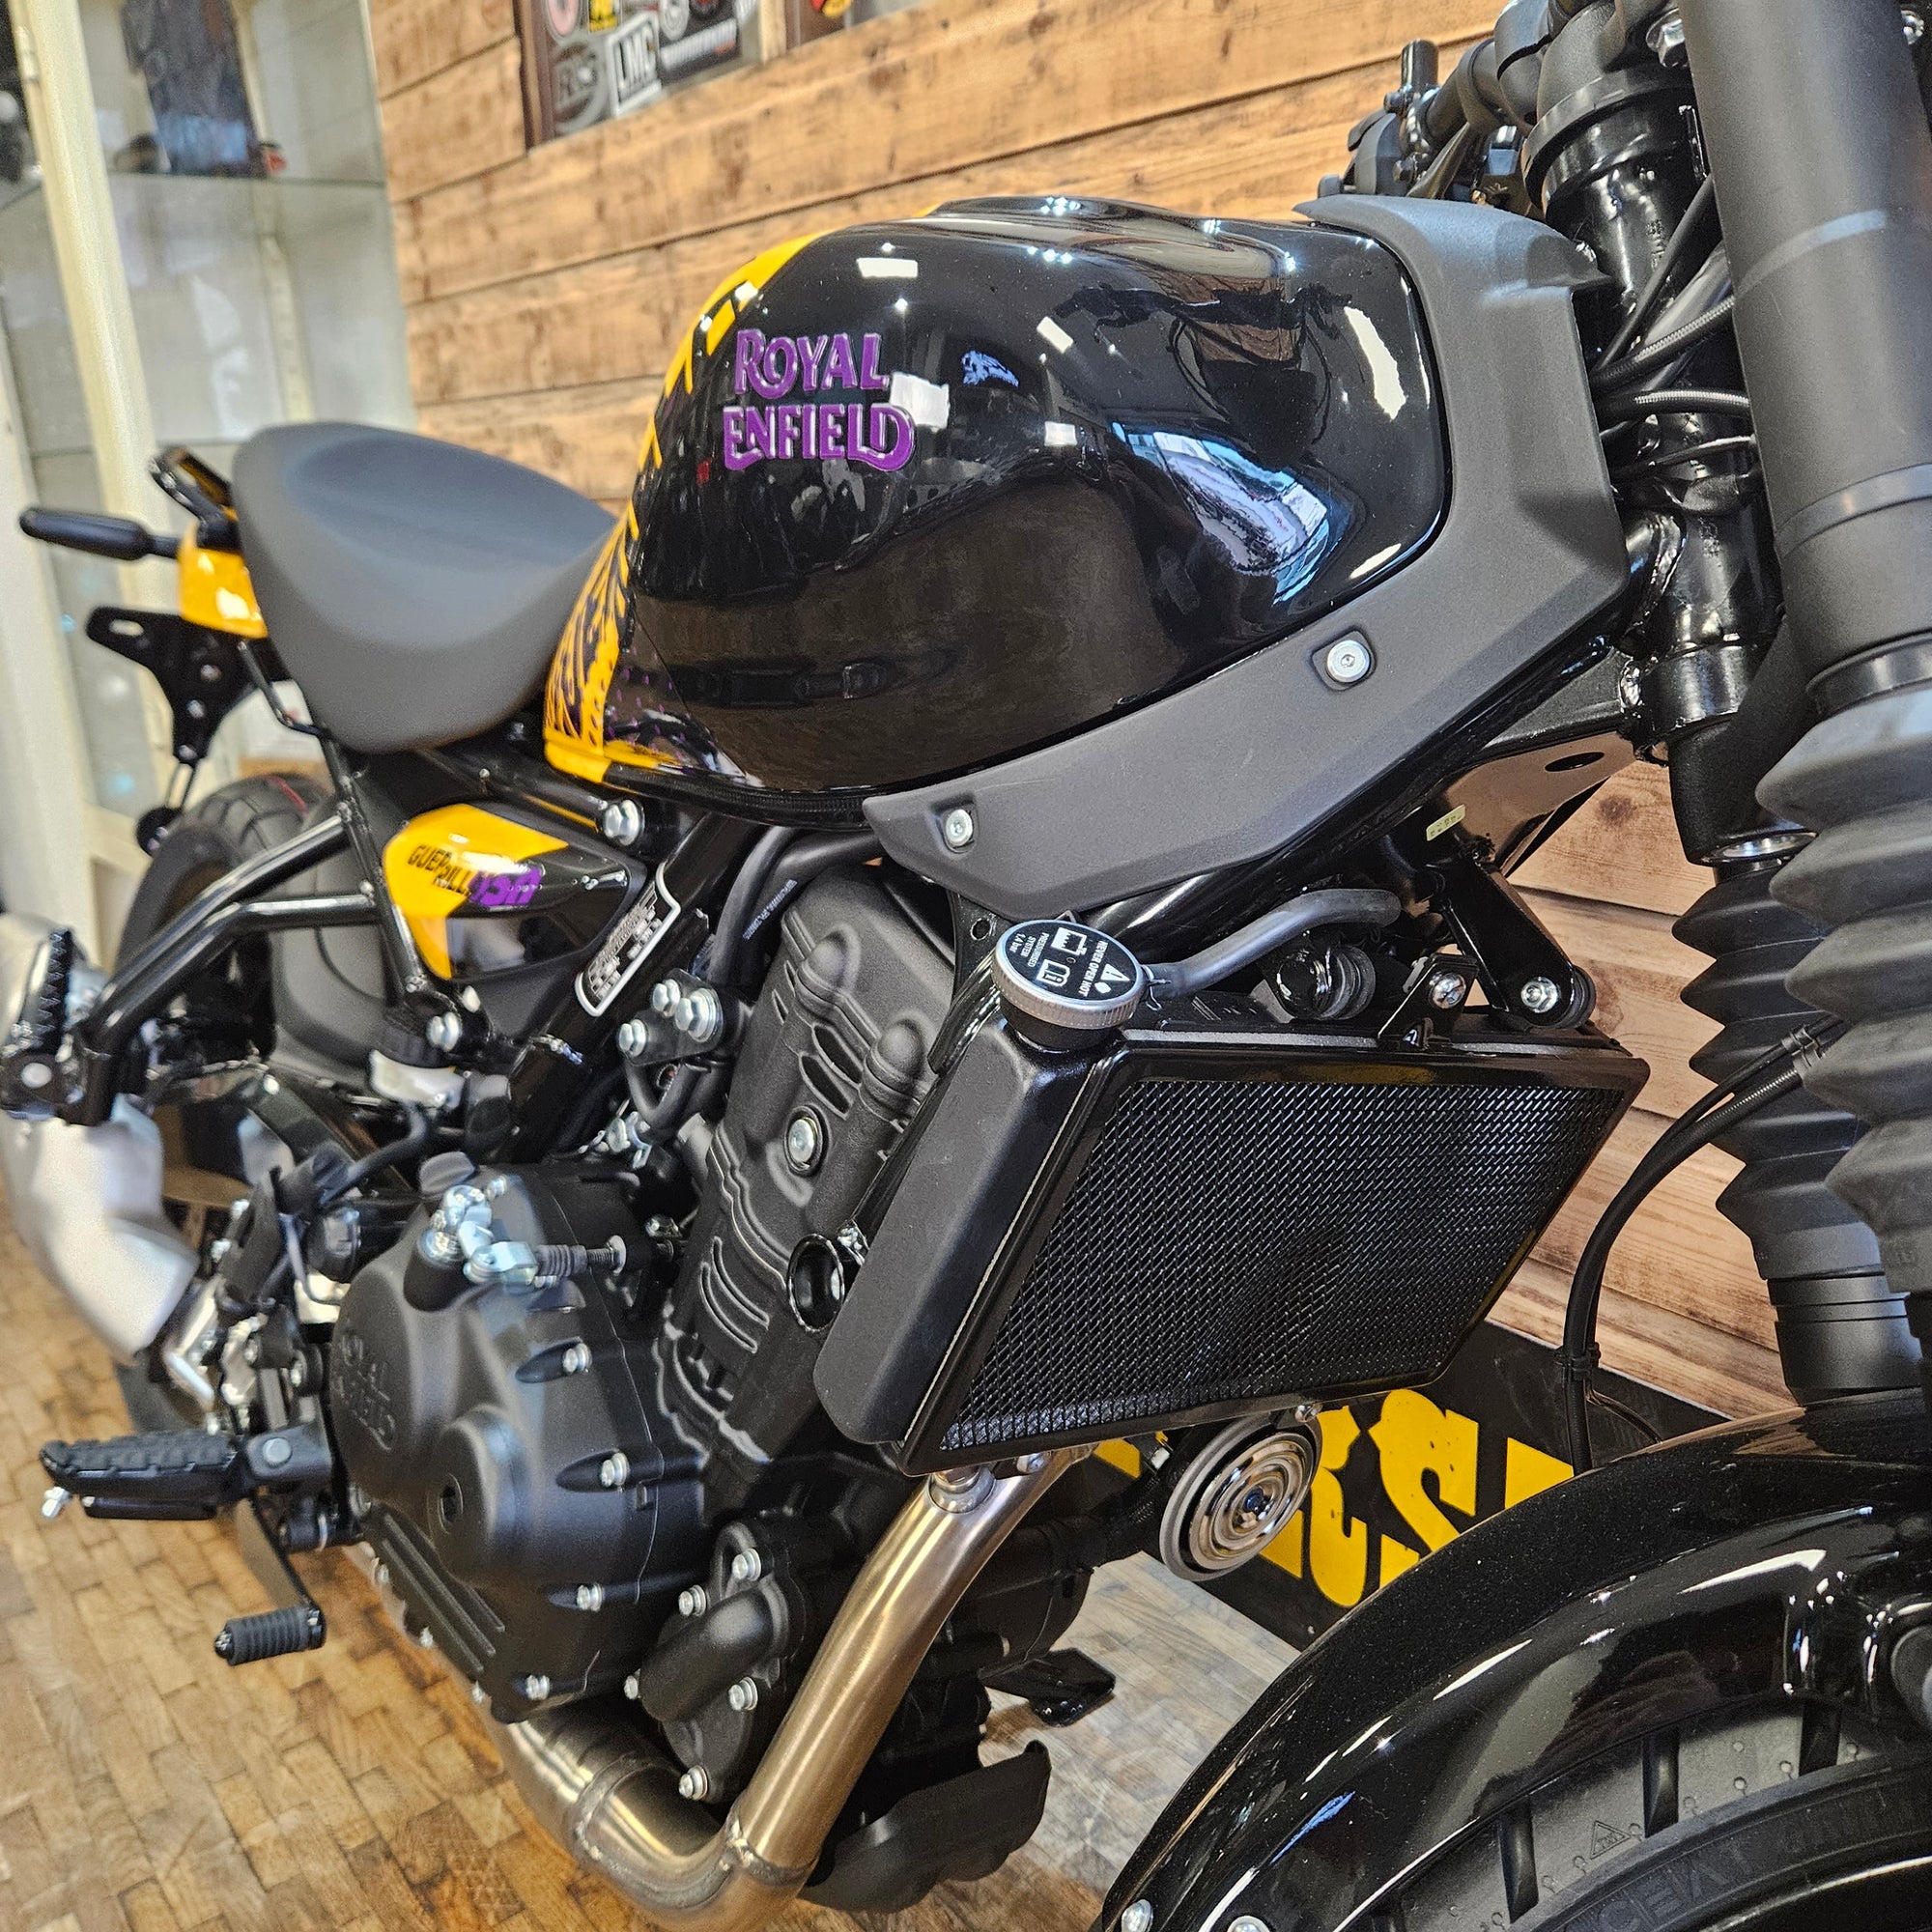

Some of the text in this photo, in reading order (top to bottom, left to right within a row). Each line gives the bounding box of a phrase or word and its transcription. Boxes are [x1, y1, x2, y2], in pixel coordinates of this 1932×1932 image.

[734, 328, 890, 399] ROYAL
[723, 403, 916, 471] ENFIELD
[1020, 936, 1036, 957] SYSTEM
[1078, 940, 1108, 997] NEVER OPEN HOT
